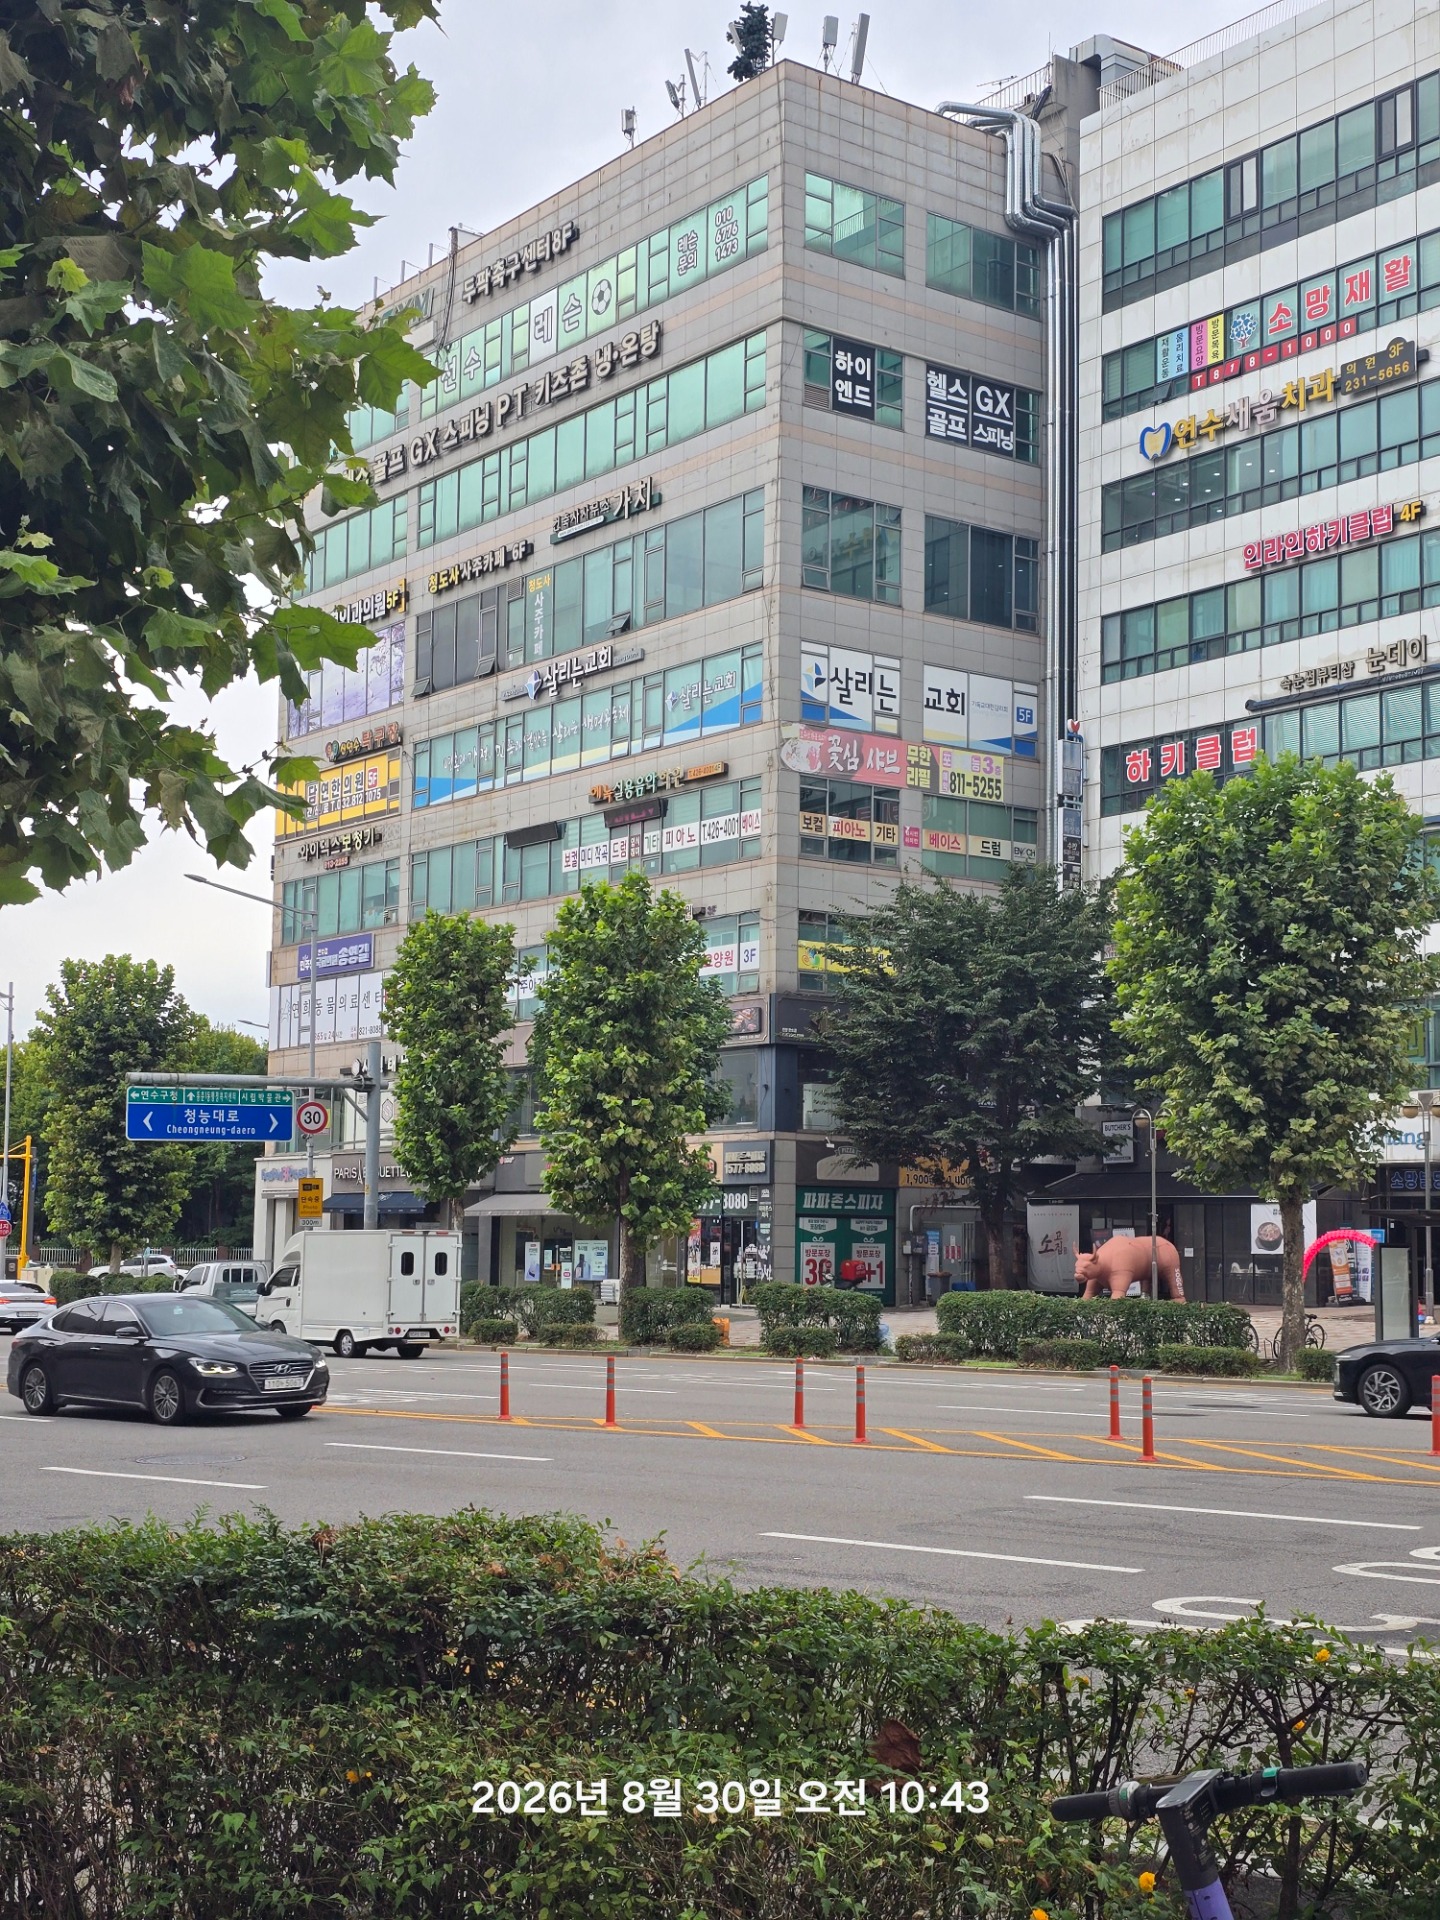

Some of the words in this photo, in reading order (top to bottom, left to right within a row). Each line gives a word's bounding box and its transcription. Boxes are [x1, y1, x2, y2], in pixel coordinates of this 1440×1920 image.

[715, 206, 733, 227] 010
[678, 230, 698, 253] 레슨
[715, 226, 738, 244] 6776
[715, 242, 738, 262] 1473
[677, 252, 697, 277] 문의
[835, 350, 871, 381] 하이
[1345, 360, 1411, 393] 231-5656
[835, 379, 872, 407] 엔드
[926, 370, 968, 405] 헬스
[1173, 367, 1335, 449] 연수세움치과
[1388, 342, 1404, 359] 3F
[411, 428, 439, 465] GX
[443, 402, 492, 450] 스피닝
[534, 356, 589, 407] 키즈존
[975, 385, 1011, 418] GX
[927, 408, 968, 440] 골프
[973, 423, 1014, 451] 스피닝
[613, 476, 653, 519] 가치
[1243, 504, 1393, 570] 인라인하키클럽
[1400, 500, 1422, 522] 4F
[511, 540, 528, 560] 6F
[528, 573, 551, 593] 청도사
[387, 590, 399, 609] 5F
[1280, 662, 1355, 692] 속눈썹뷰티샵
[1366, 635, 1427, 674] 눈데이
[830, 667, 897, 712] 살리는
[924, 687, 965, 716] 교회
[1018, 708, 1032, 722] 5F
[906, 744, 932, 766] 무한
[1126, 727, 1258, 783] 하키클럽
[906, 766, 931, 788] 리필
[950, 771, 1002, 800] 811-5255
[702, 816, 739, 842] T.426-4001
[742, 812, 761, 831] 베이스
[802, 815, 824, 833] 보컬
[832, 820, 866, 839] 피아노
[644, 831, 660, 852] 기타
[665, 827, 696, 848] 피아노
[876, 826, 896, 842] 기타
[929, 832, 961, 851] 베이스
[612, 840, 627, 858] 드럼
[980, 840, 1001, 857] 드럼
[743, 948, 756, 963] 3F
[141, 1090, 178, 1101] 연수구청
[241, 1091, 282, 1103] 시립박물관
[184, 1109, 240, 1124] 청능대로
[304, 1111, 321, 1125] 30
[167, 1124, 256, 1136] Cheongneung-daero
[334, 1167, 357, 1179] PARIS
[802, 1192, 883, 1211] 파파존스피자
[805, 1249, 831, 1258] 방문포장
[856, 1249, 881, 1258] 방문포장
